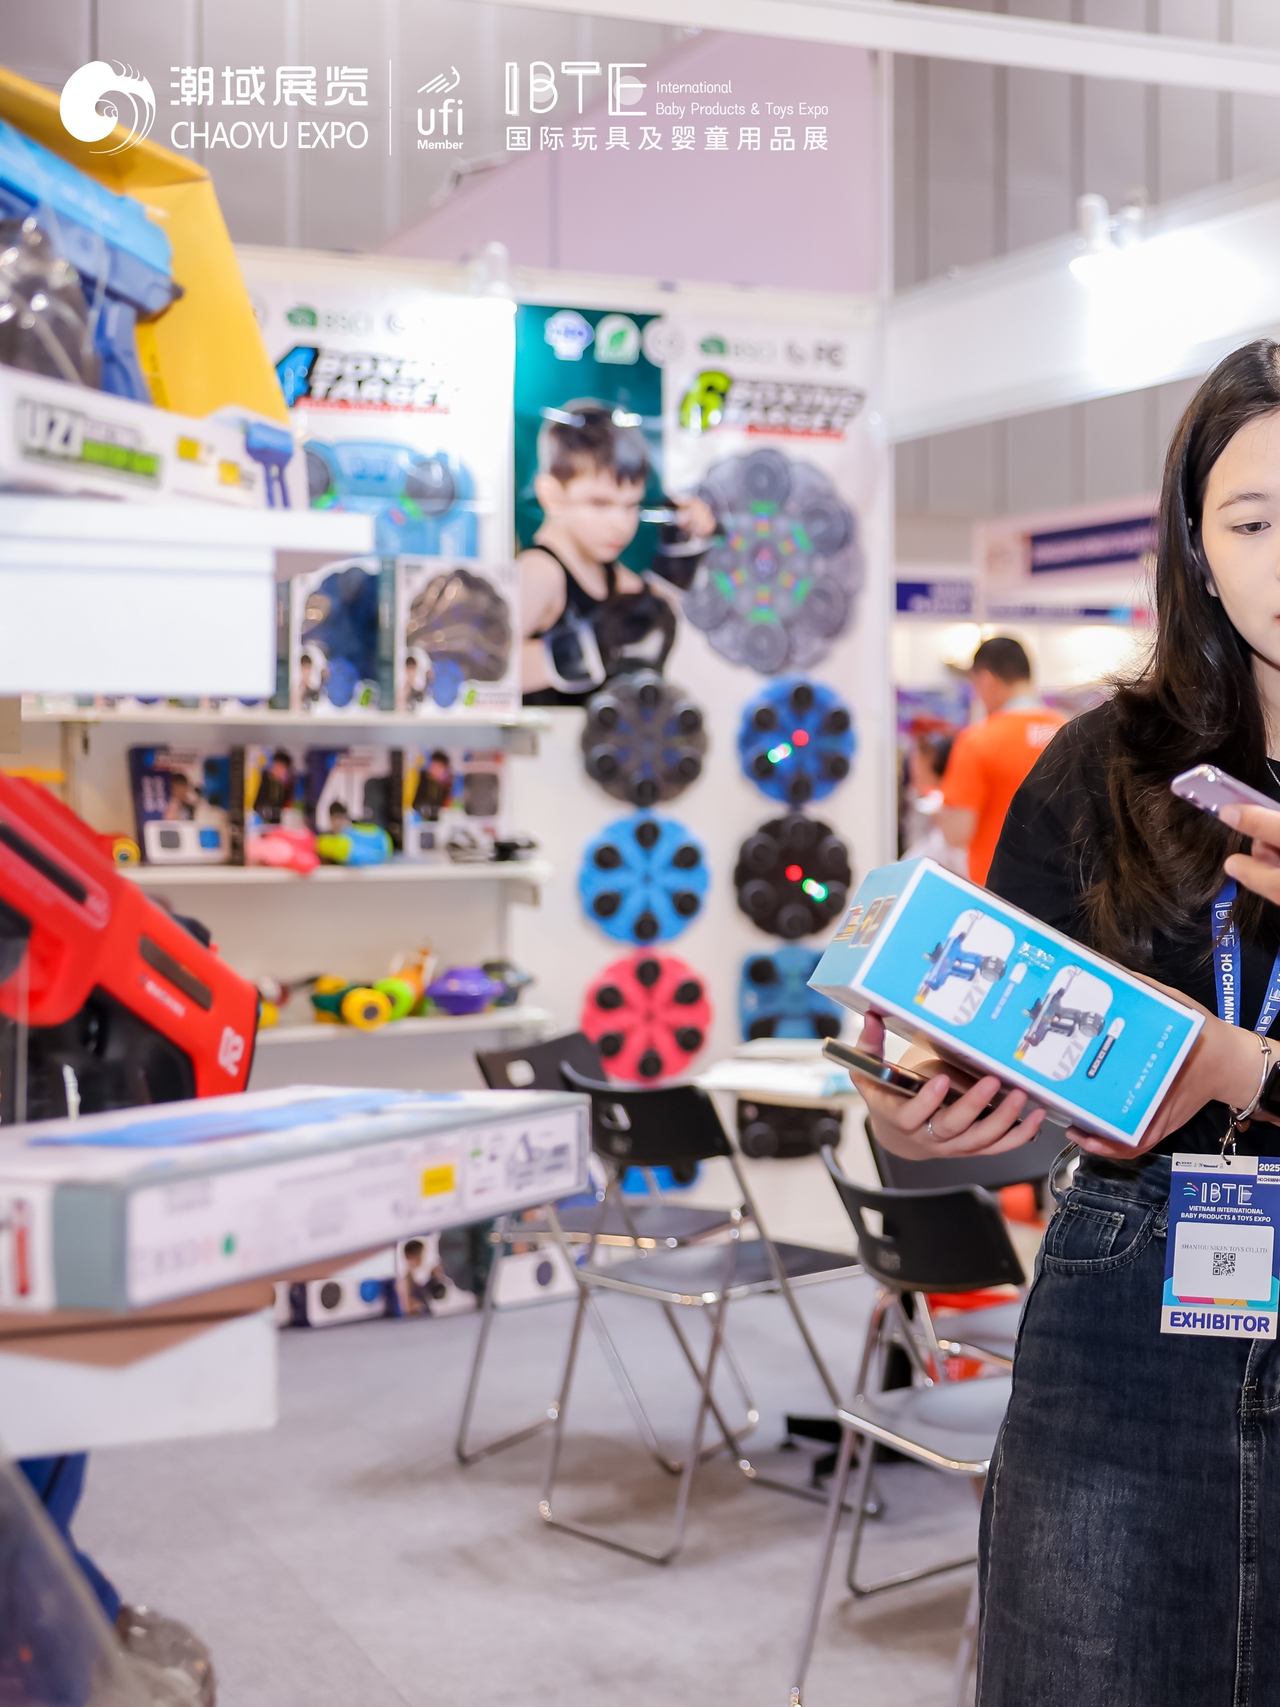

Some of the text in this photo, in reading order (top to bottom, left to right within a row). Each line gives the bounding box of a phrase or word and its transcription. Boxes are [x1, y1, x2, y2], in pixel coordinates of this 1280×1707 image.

[1134, 1053, 1158, 1090] WATER
[1259, 1163, 1280, 1172] 2025
[1201, 1182, 1253, 1205] IBTE
[1217, 1206, 1264, 1215] INTERNATIONAL
[1170, 1310, 1270, 1333] EXHIBITOR
